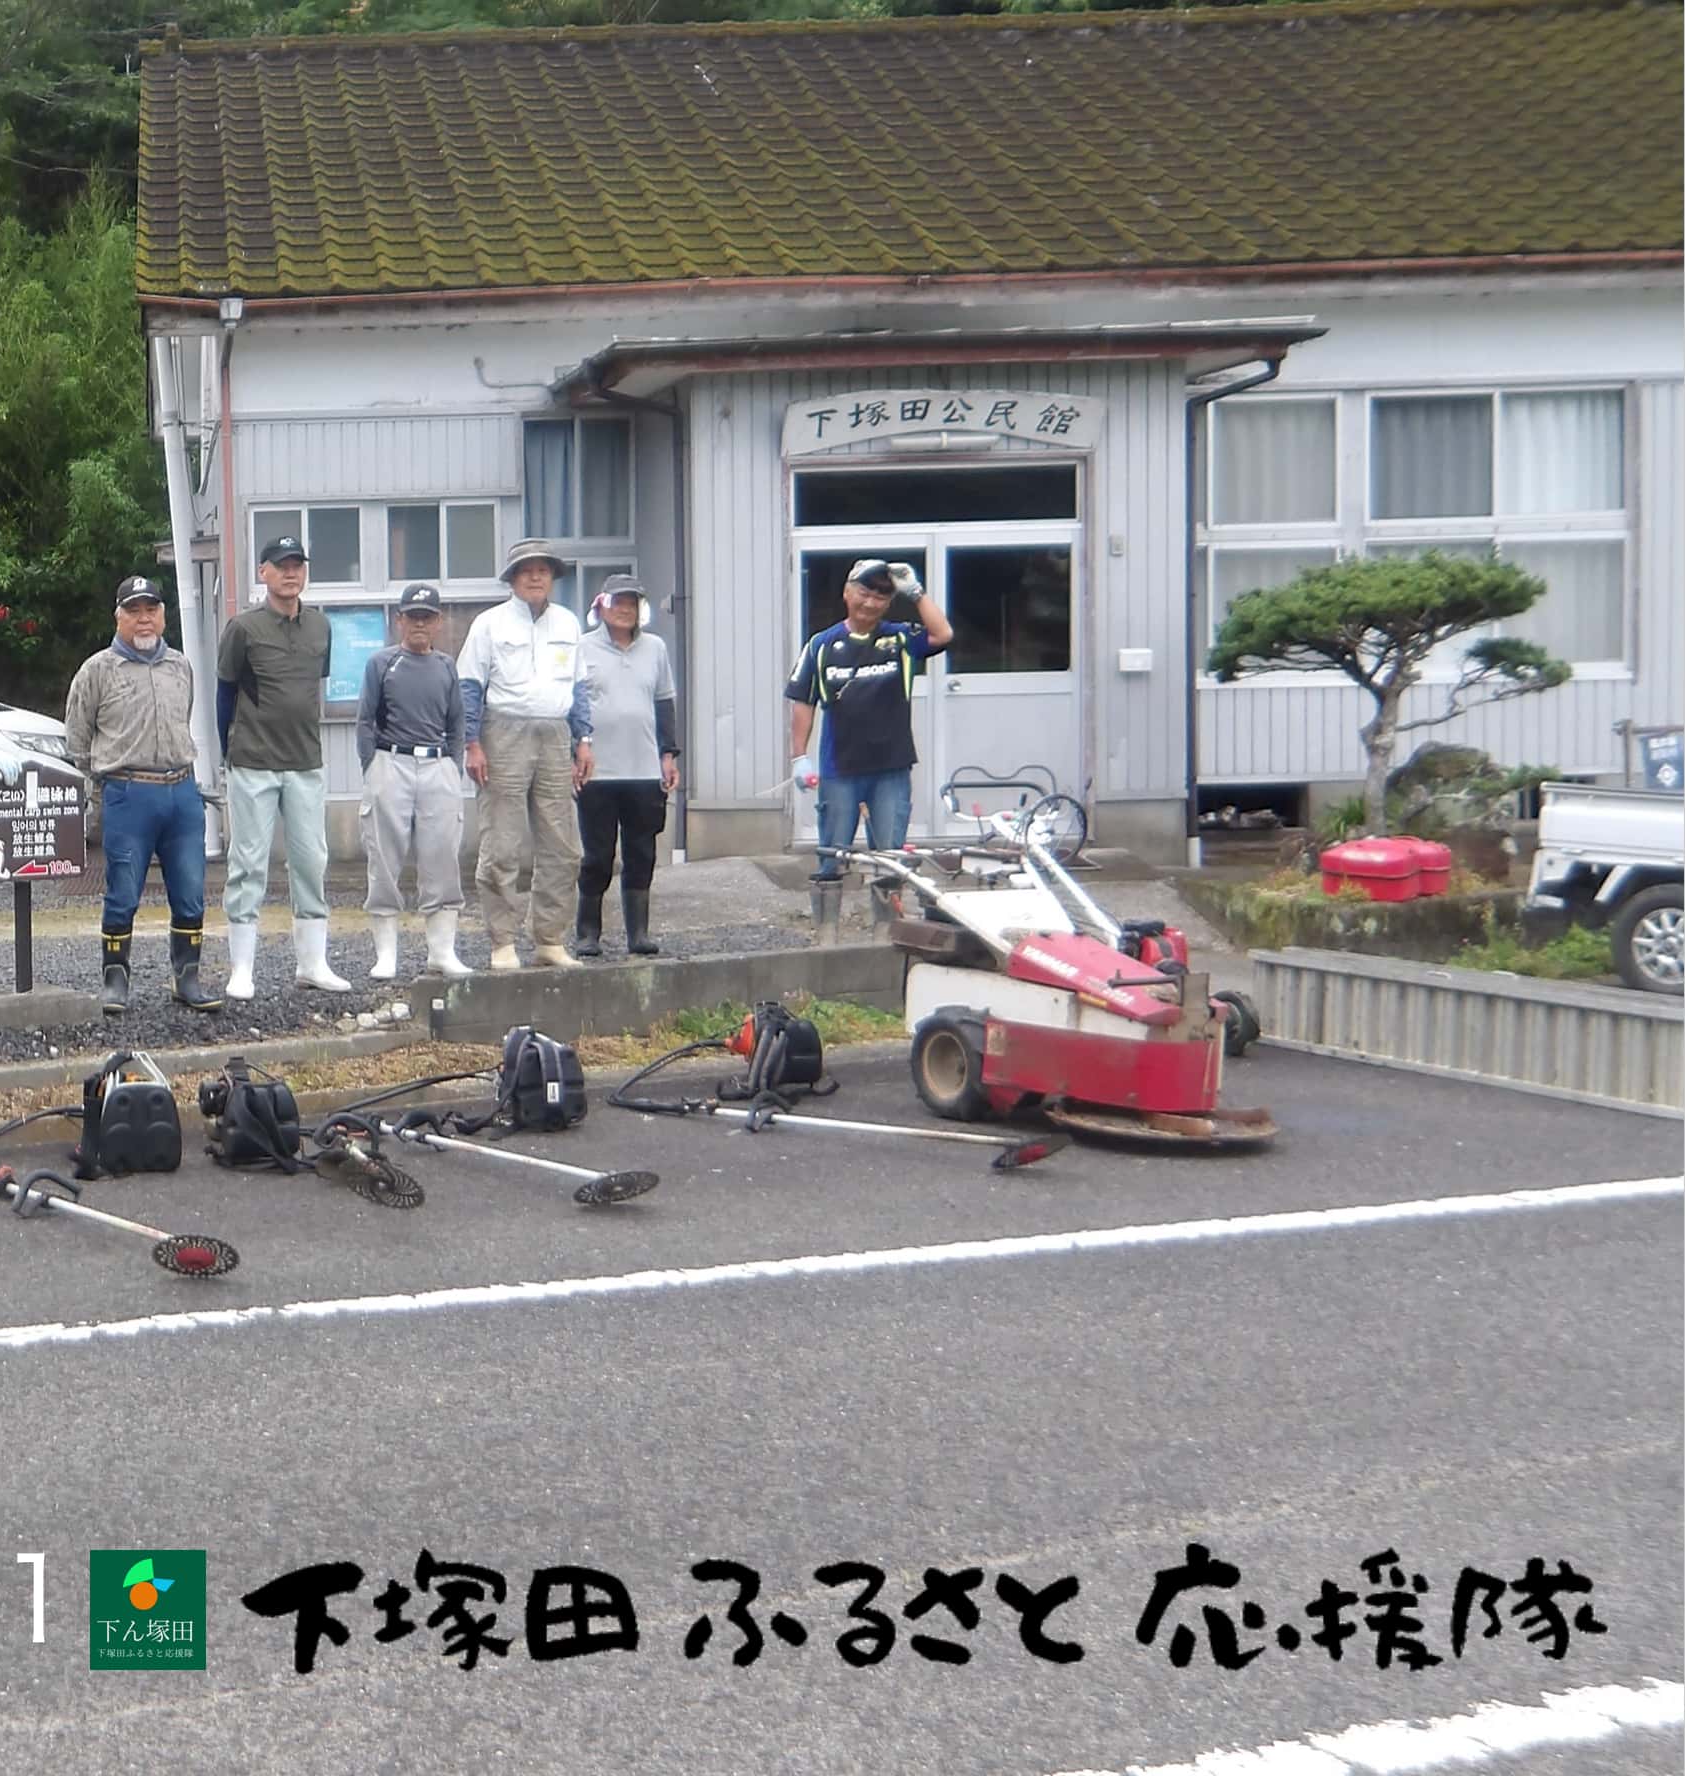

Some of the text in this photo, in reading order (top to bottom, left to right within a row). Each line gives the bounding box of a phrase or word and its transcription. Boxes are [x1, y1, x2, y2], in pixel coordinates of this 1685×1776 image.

[806, 396, 1081, 438] 下塚田公民館
[43, 805, 61, 816] swim
[63, 806, 80, 816] zone
